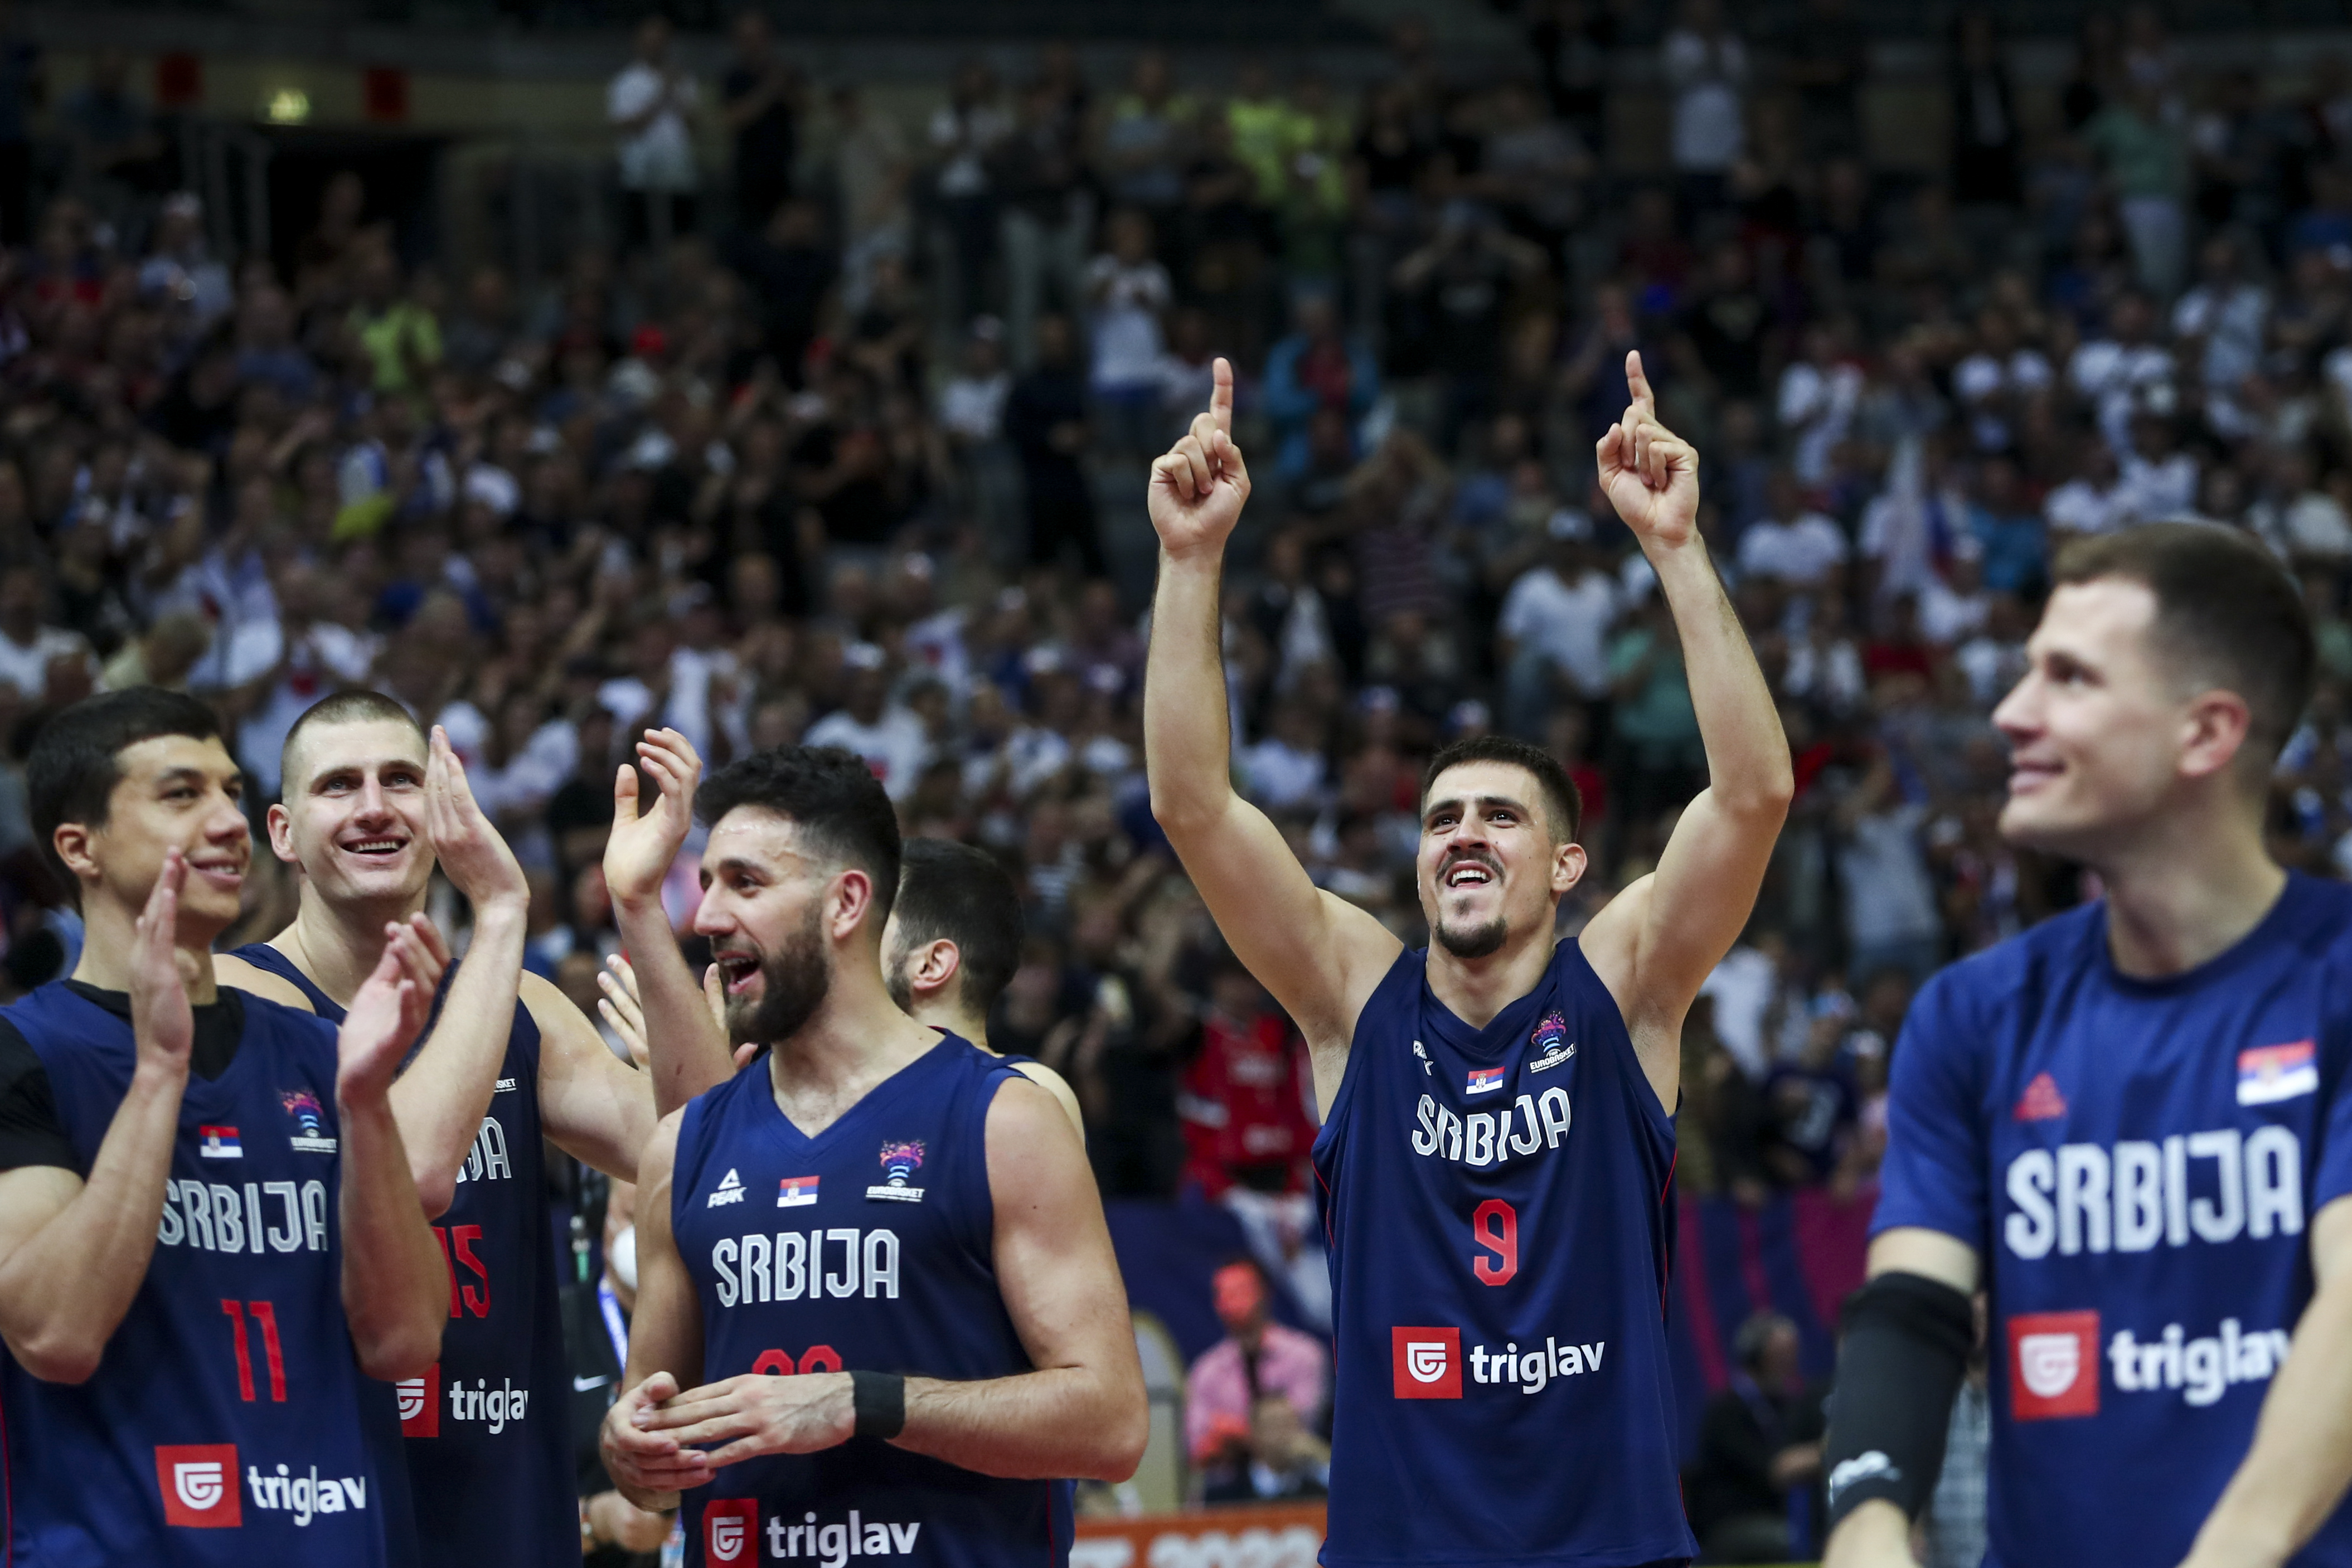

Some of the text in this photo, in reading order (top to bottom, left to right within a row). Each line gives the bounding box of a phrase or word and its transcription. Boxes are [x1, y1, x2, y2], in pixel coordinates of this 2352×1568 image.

[1530, 1043, 1574, 1070] EUROBASKET
[1412, 1086, 1571, 1166] SRBIJA
[158, 1178, 328, 1254] SRBIJA
[707, 1187, 747, 1208] PEAK
[2004, 1124, 2305, 1260] SRBIJA
[712, 1228, 900, 1308] SRBIJA
[1473, 1198, 1517, 1287] 9
[220, 1299, 288, 1402] 11
[1469, 1336, 1605, 1395] triglav
[248, 1463, 366, 1527] triglav
[766, 1509, 921, 1568] triglav
